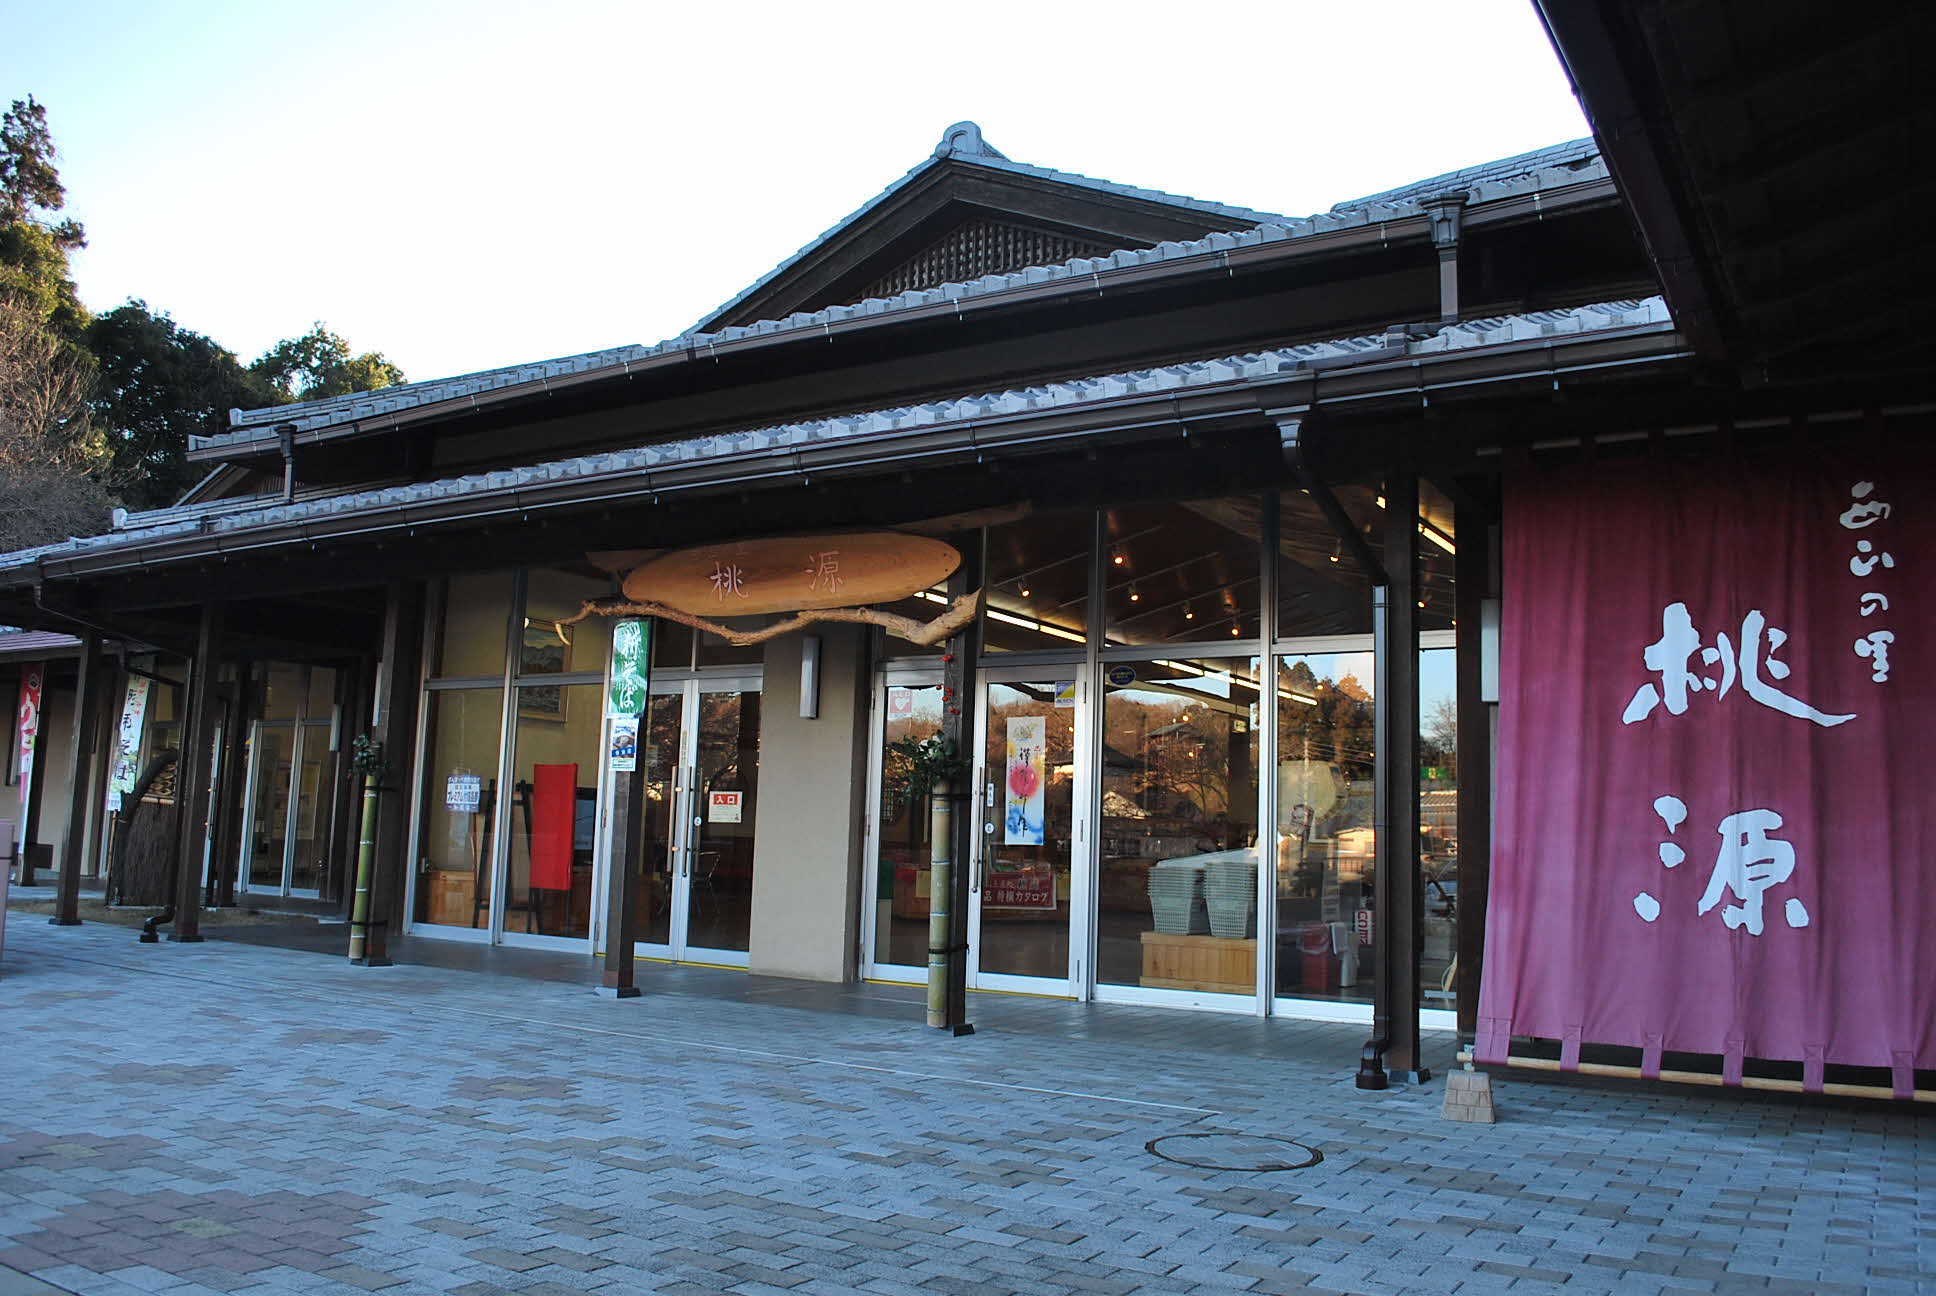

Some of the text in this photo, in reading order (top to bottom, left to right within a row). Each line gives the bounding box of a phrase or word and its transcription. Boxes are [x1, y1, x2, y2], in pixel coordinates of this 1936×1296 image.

[709, 549, 845, 602] 桃源
[1622, 601, 1858, 937] 桃源
[716, 795, 736, 804] 入口
